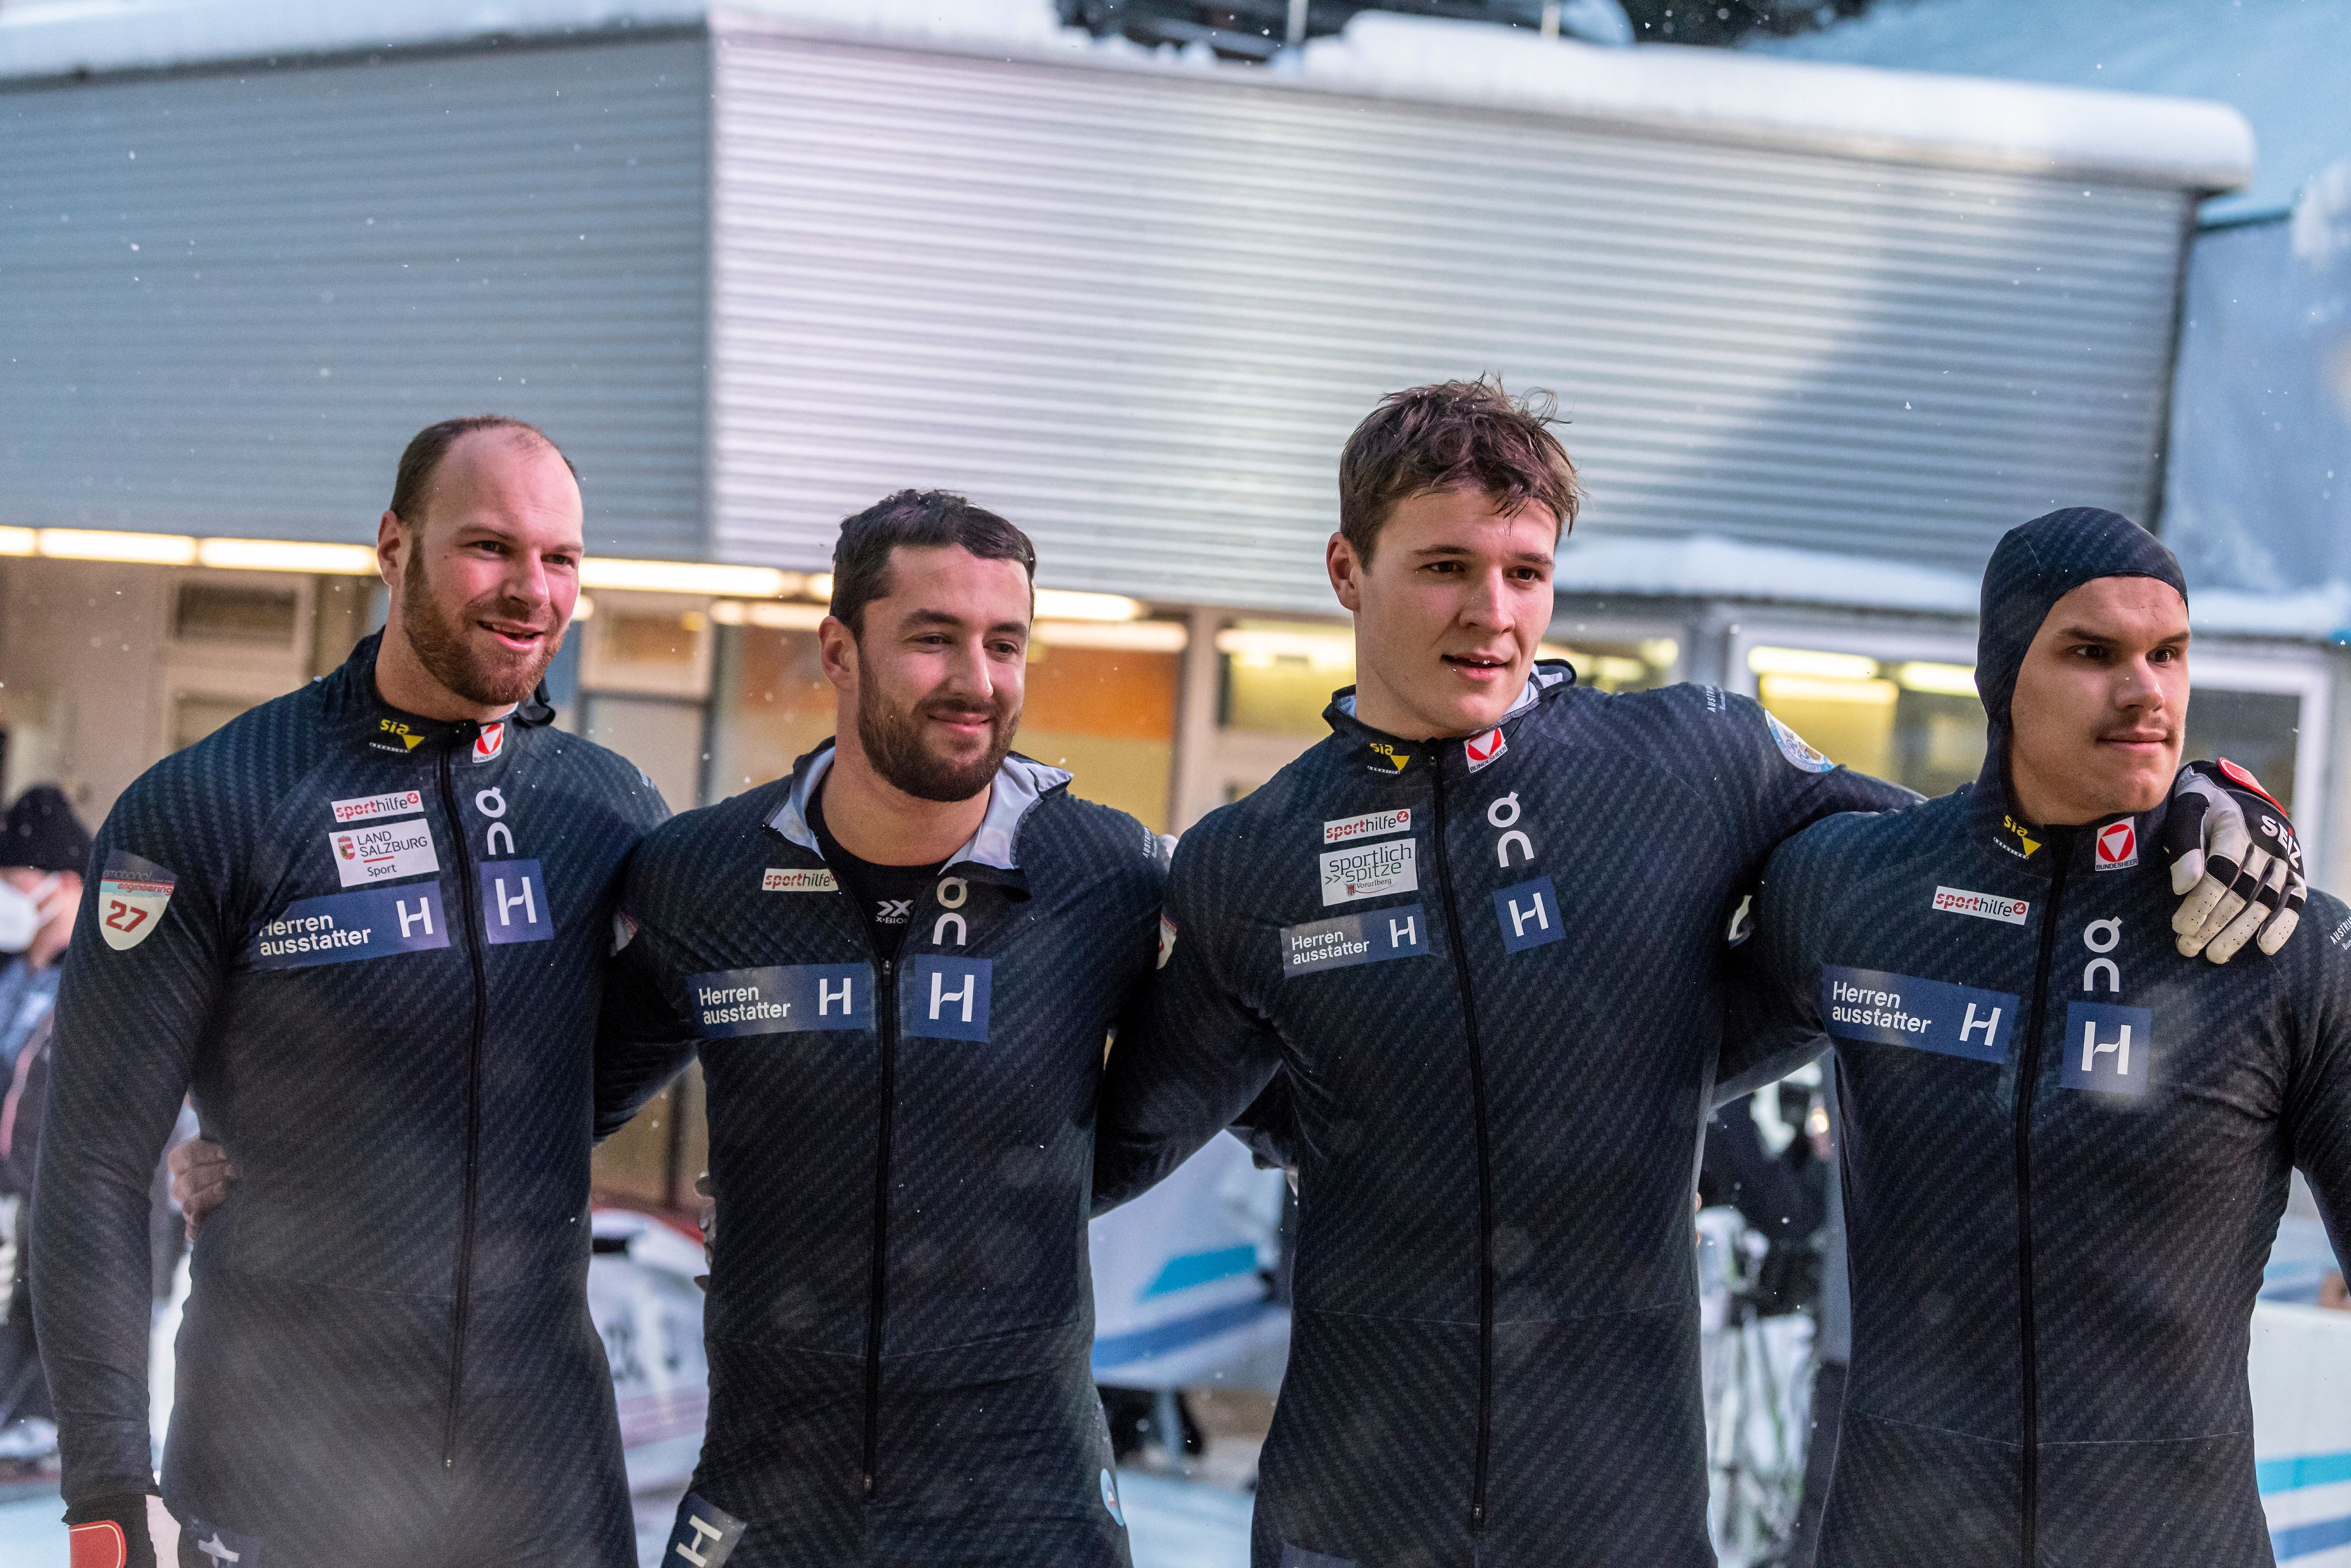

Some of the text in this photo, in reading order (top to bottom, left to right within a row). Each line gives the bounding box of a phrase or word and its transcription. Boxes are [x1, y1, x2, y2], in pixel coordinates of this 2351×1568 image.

[380, 719, 410, 735] sia
[1369, 742, 1394, 756] sia
[1470, 746, 1507, 772] BUNDESHEER
[336, 797, 407, 820] sporthilfe
[1326, 815, 1396, 840] sporthilfe
[2004, 815, 2028, 837] sia
[357, 831, 391, 845] LAND
[360, 836, 427, 857] SALZBURG
[1329, 843, 1412, 875] sportlich
[2096, 859, 2138, 870] BUNDESHEER
[367, 864, 397, 877] Sport
[765, 873, 830, 889] sporthilfe
[1345, 861, 1402, 883] spitze
[118, 883, 173, 896] engineering
[1357, 878, 1392, 889] Vorarlberg
[1935, 892, 2012, 917] sporthilfe
[106, 900, 148, 933] 27
[260, 927, 371, 956] ausstatter
[1291, 930, 1344, 951] Herren
[1293, 940, 1369, 964] ausstatter
[698, 986, 759, 1006] Herren
[1833, 981, 1901, 1009] Herren
[703, 1002, 791, 1025] ausstatter
[1832, 1006, 1931, 1033] ausstatter
